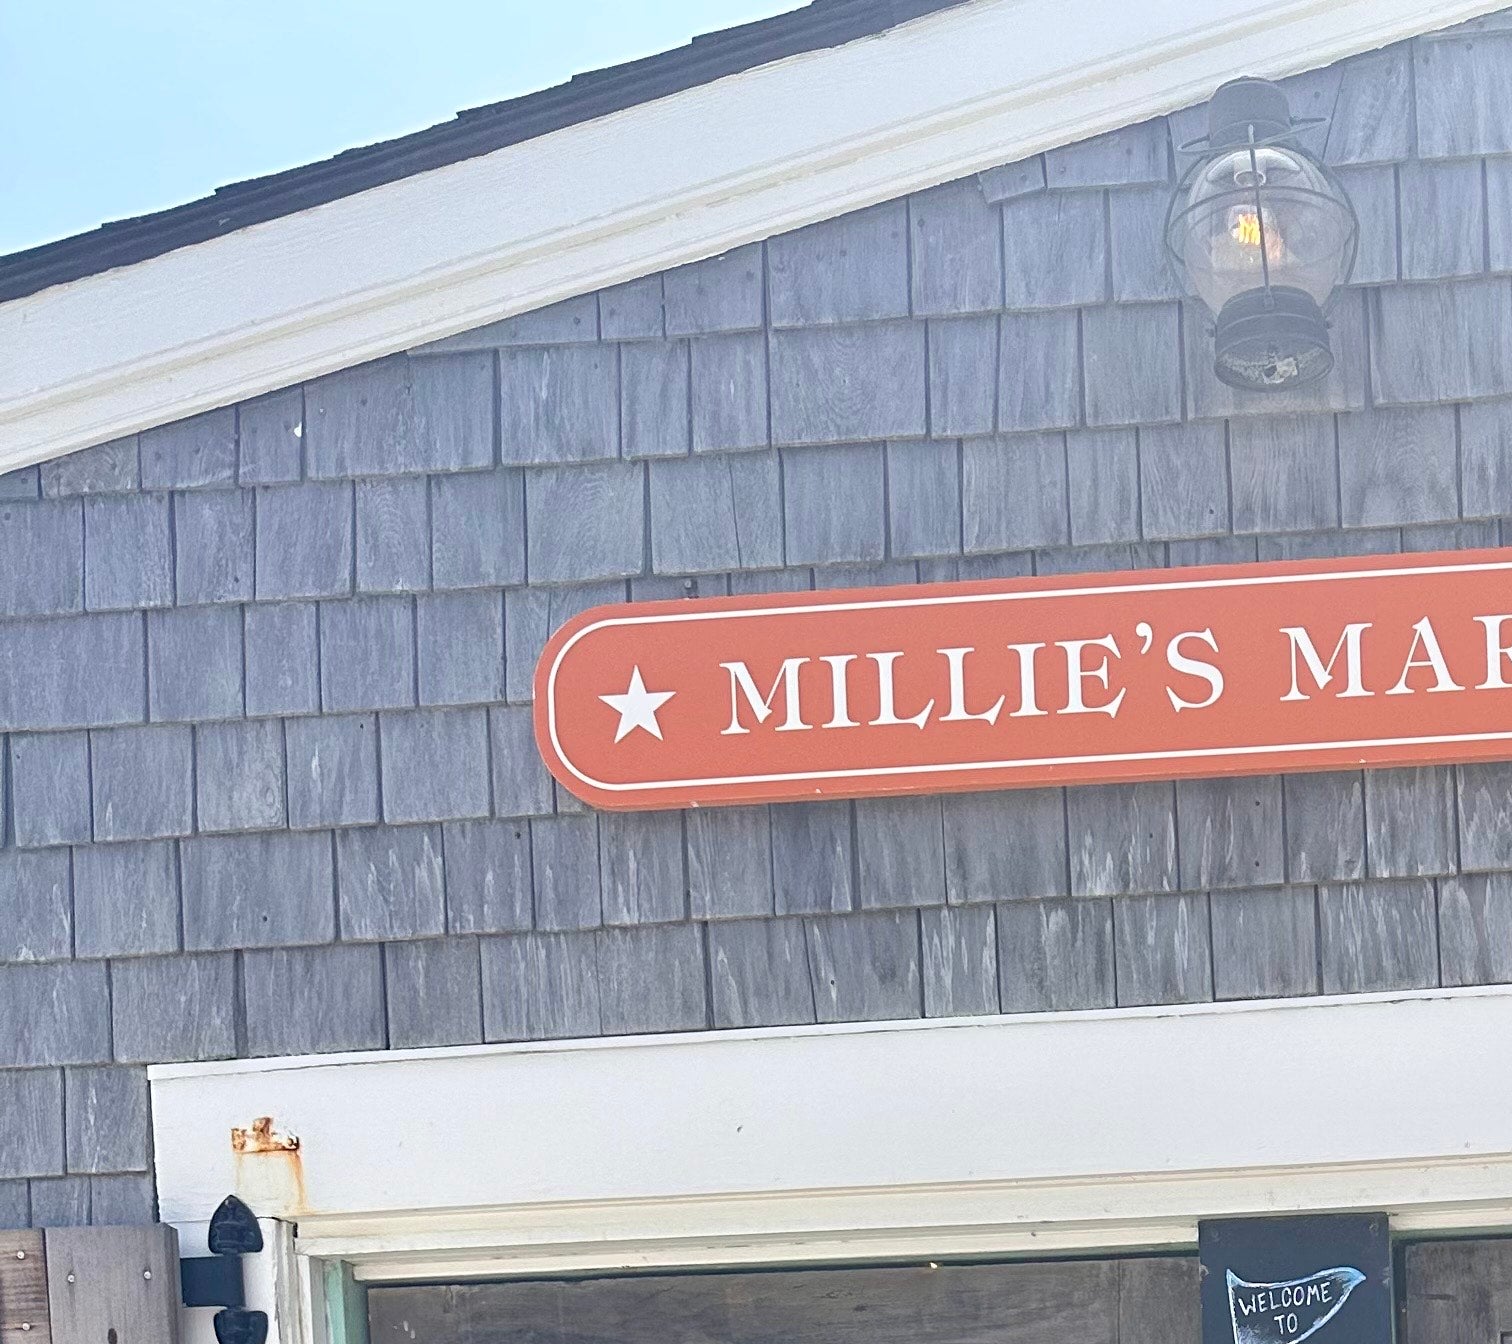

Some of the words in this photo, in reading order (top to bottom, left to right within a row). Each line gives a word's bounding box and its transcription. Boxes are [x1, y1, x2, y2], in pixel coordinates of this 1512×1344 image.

[718, 620, 1225, 738] MILLIE'S
[1238, 1281, 1332, 1316] WELCOME
[1273, 1312, 1299, 1335] TO
